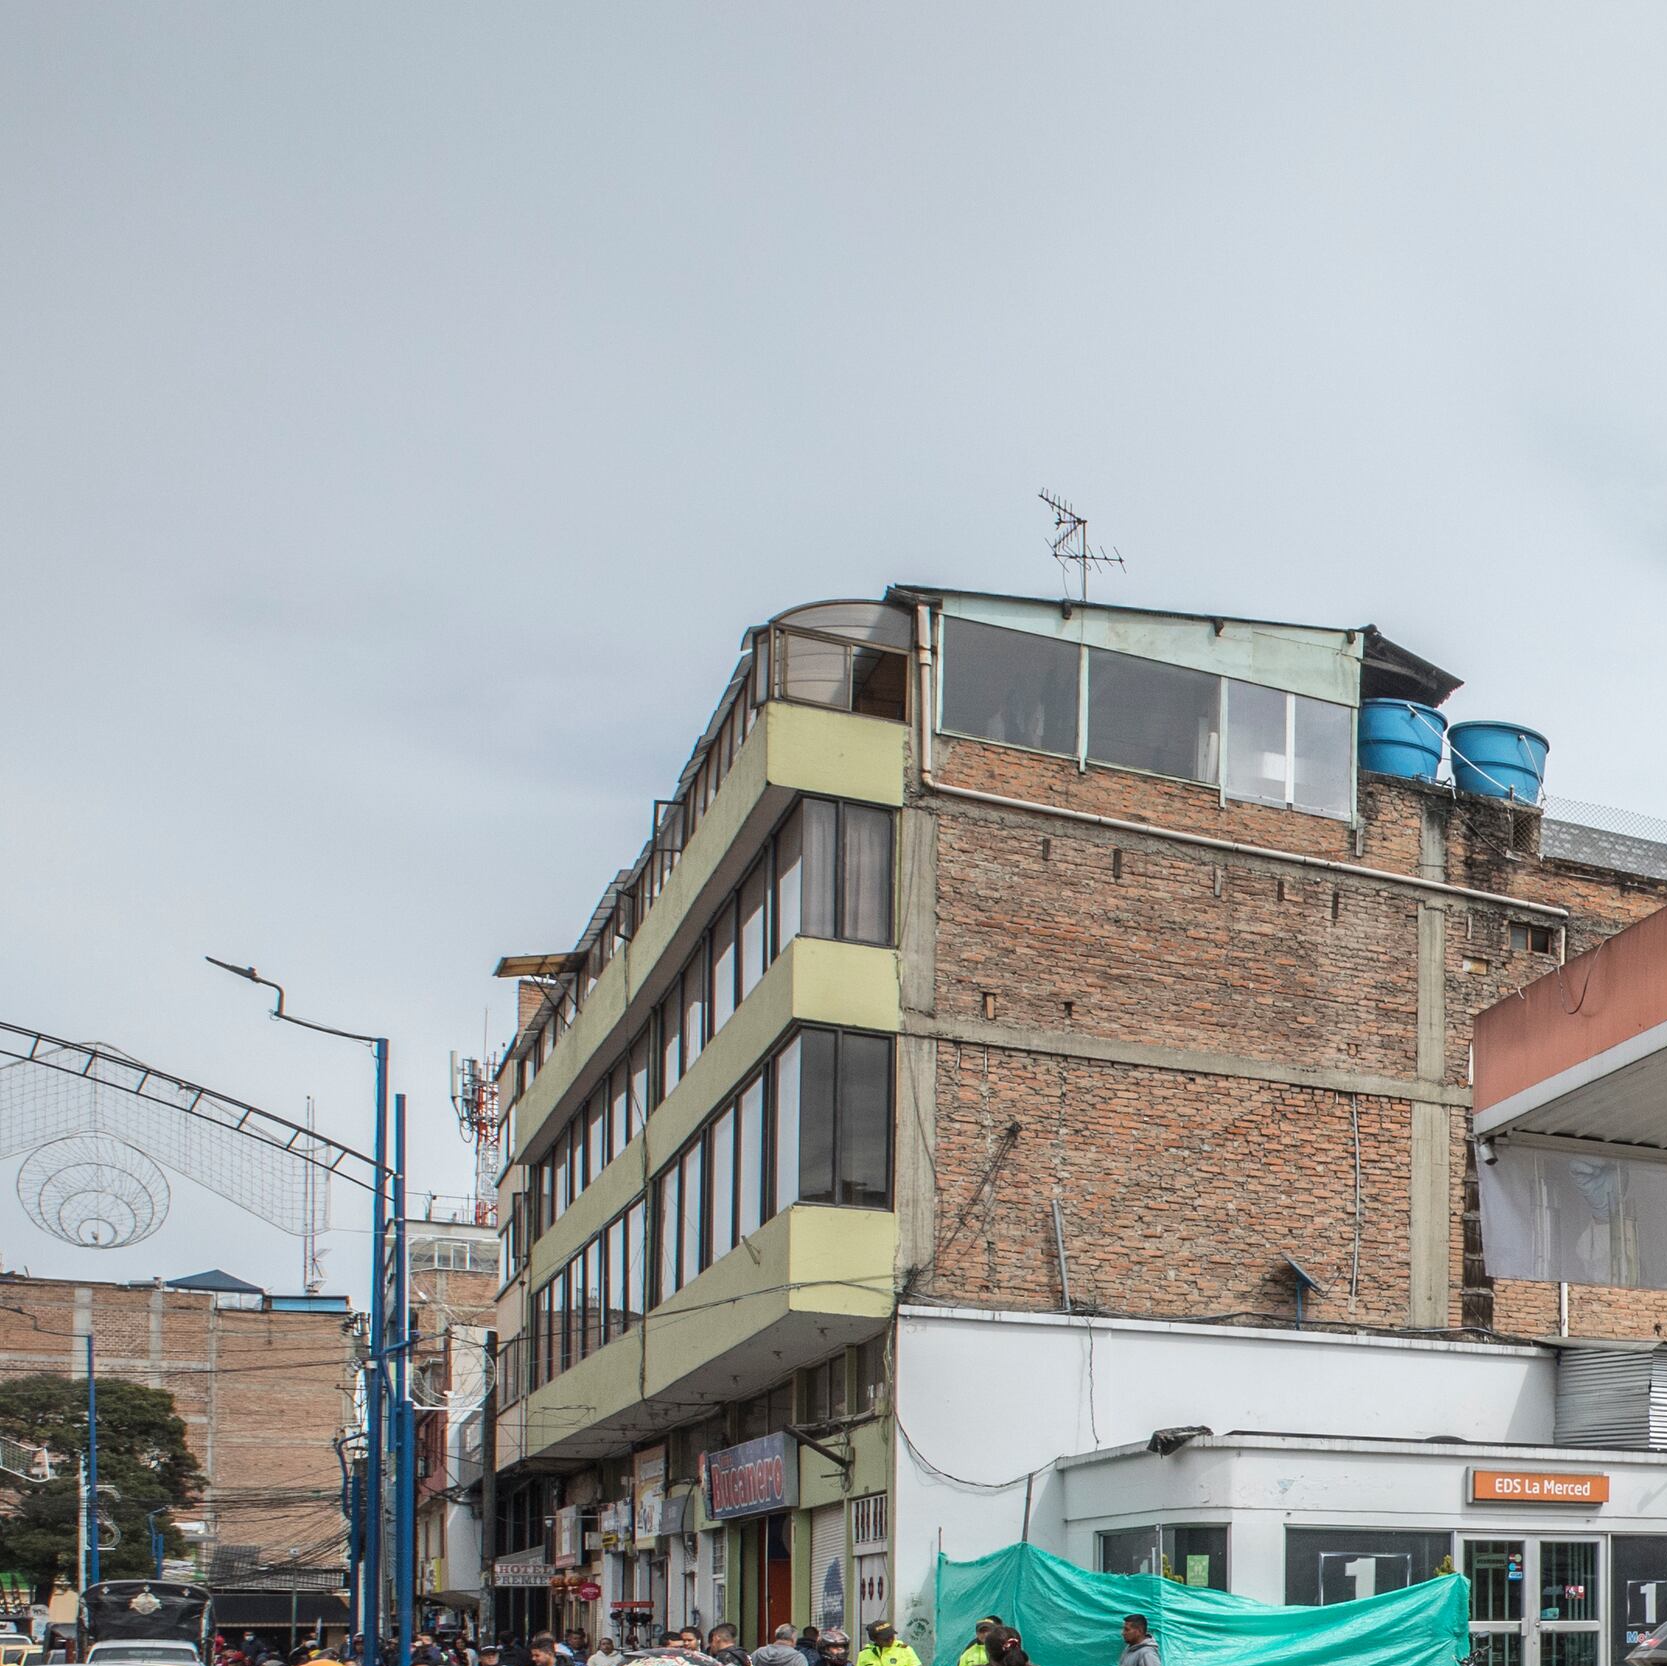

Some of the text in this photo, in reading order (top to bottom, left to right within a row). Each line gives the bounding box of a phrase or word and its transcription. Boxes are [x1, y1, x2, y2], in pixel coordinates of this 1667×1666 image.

[711, 1456, 783, 1513] Bucanero
[1495, 1478, 1591, 1496] EDS La Merced
[498, 1563, 551, 1575] HOTEL
[1640, 1583, 1656, 1623] 1
